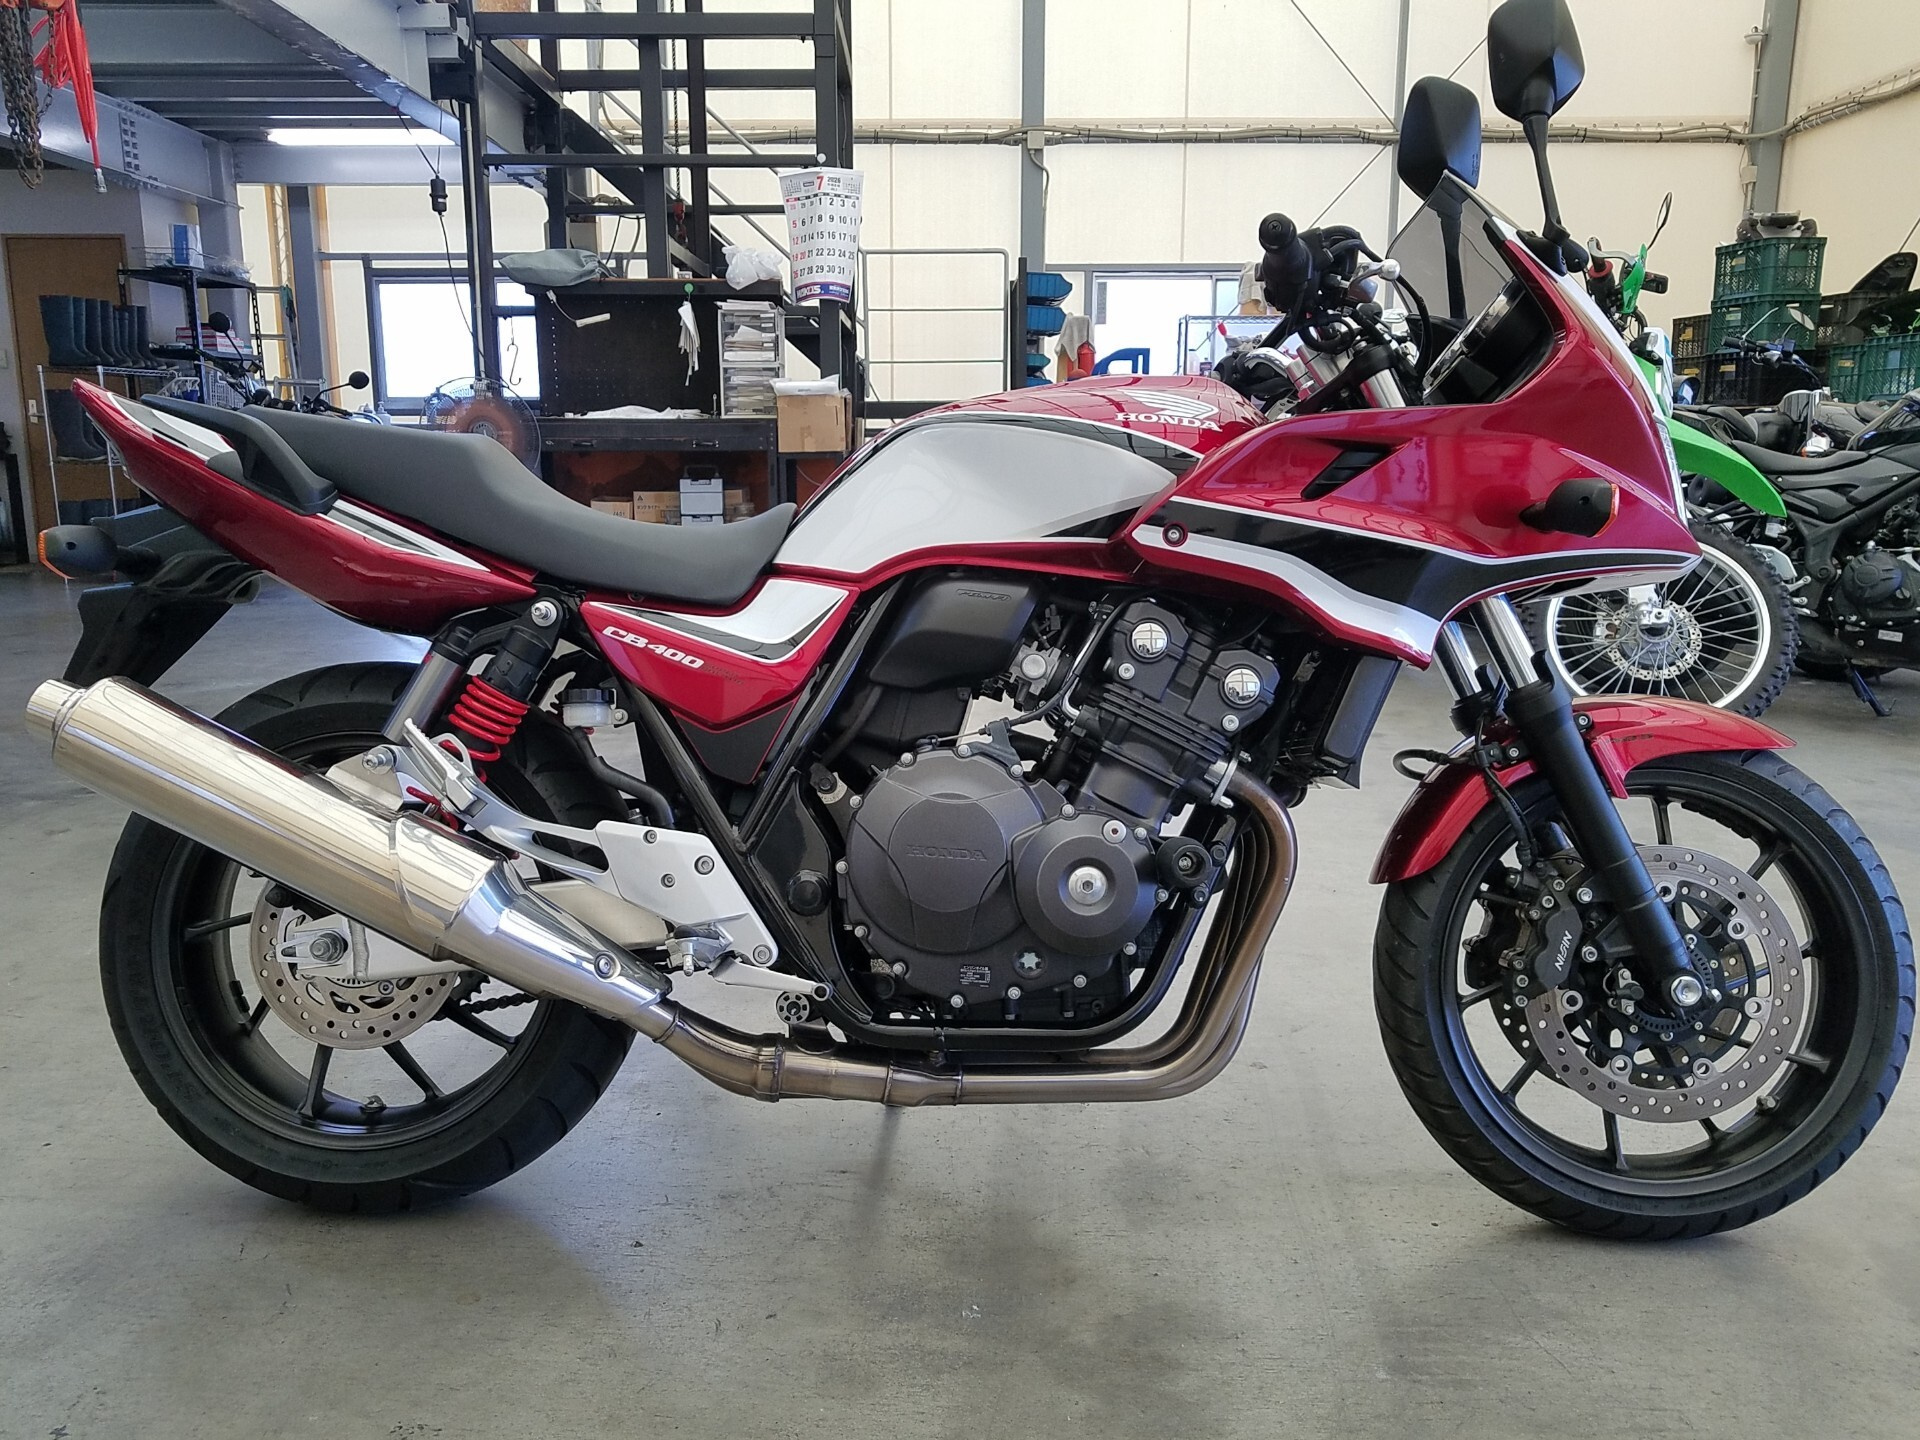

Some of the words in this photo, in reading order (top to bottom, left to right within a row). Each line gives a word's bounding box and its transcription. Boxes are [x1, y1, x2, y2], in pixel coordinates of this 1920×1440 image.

[816, 175, 824, 191] 7
[818, 198, 822, 206] 1
[829, 198, 835, 206] 2
[840, 199, 846, 208] 3
[851, 201, 856, 209] 4
[792, 220, 797, 229] 5
[801, 218, 806, 227] 6
[809, 216, 814, 224] 7
[817, 214, 823, 223] 8
[829, 214, 834, 223] 9
[839, 216, 847, 225] 10
[849, 217, 857, 226] 11
[792, 237, 799, 246] 12
[800, 234, 807, 243] 13
[808, 233, 814, 242] 14
[817, 231, 824, 240] 15
[827, 231, 836, 240] 16
[839, 233, 846, 241] 17
[849, 235, 857, 243] 18
[800, 251, 806, 260] 20
[808, 250, 813, 258] 21
[816, 248, 824, 256] 22
[827, 248, 836, 257] 23
[838, 249, 846, 258] 24
[848, 251, 855, 261] 25
[800, 268, 805, 277] 27
[807, 266, 813, 275] 28
[816, 265, 824, 273] 29
[827, 265, 835, 274] 30
[838, 266, 845, 276] 31
[1115, 412, 1223, 432] HONDA
[602, 626, 705, 669] CB400
[905, 844, 987, 862] HONDA
[1554, 930, 1573, 972] NISSIN
